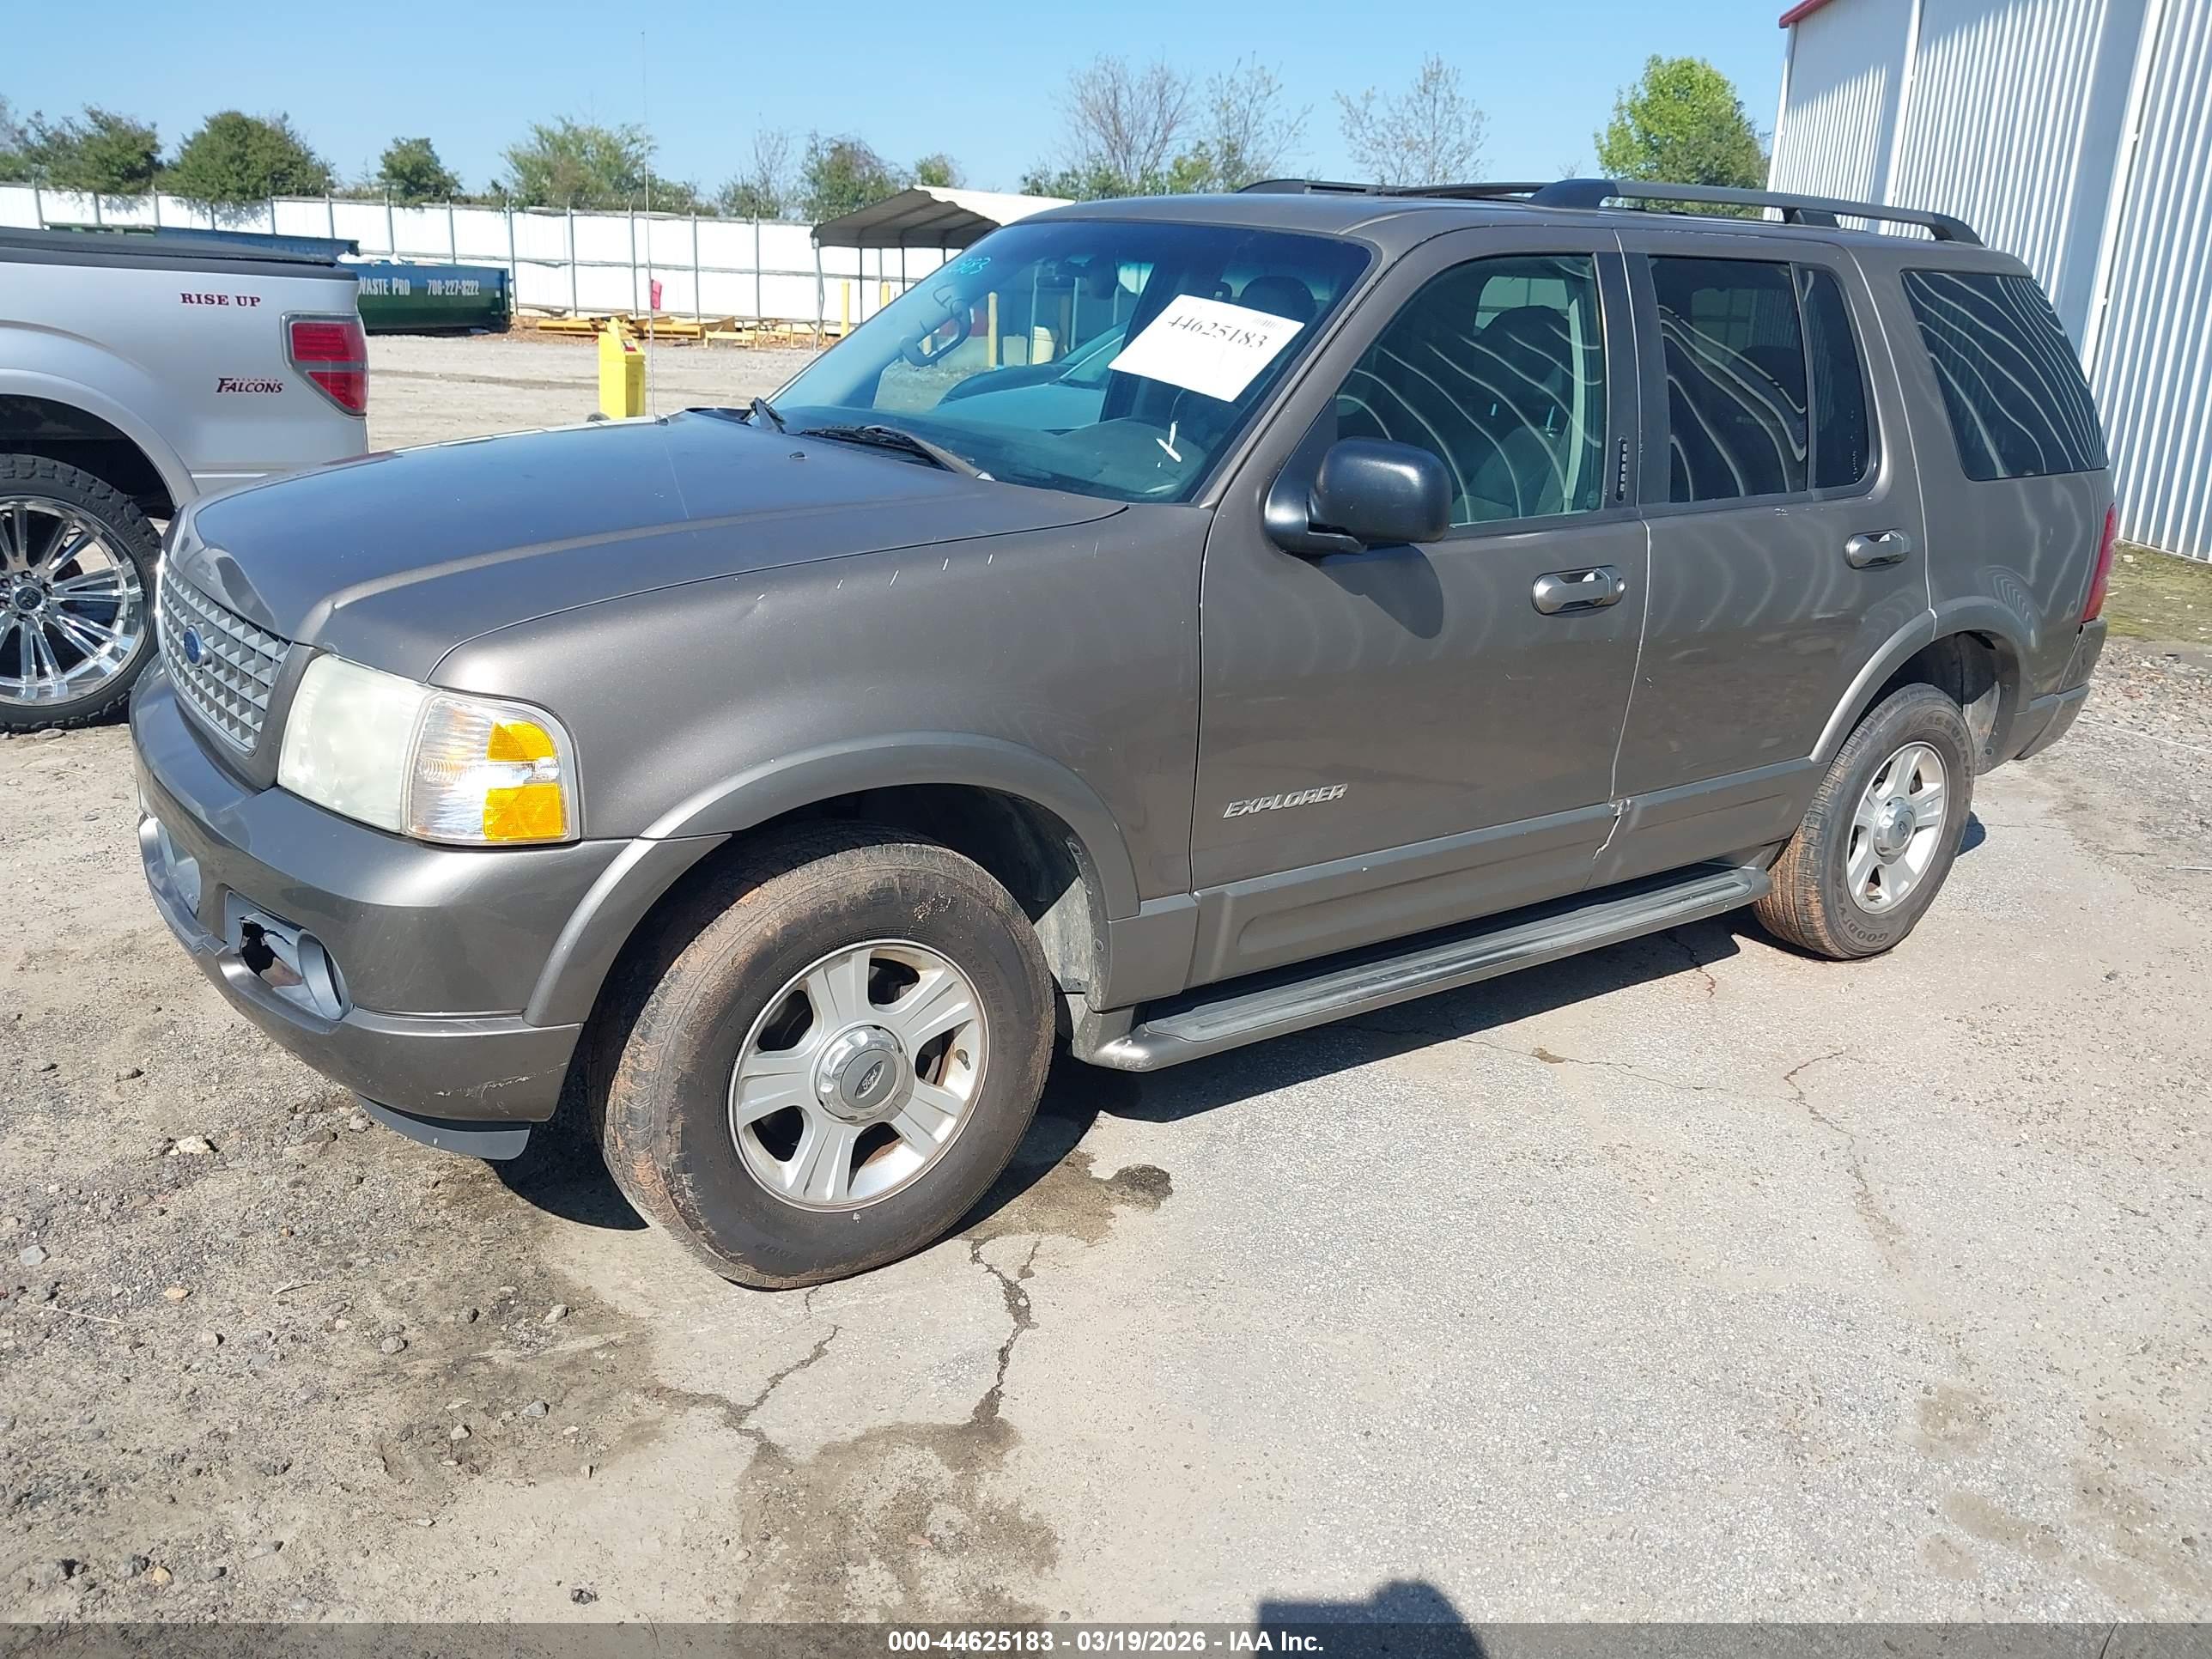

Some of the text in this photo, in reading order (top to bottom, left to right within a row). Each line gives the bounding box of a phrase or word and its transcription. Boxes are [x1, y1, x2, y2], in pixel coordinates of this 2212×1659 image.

[180, 292, 261, 307] RISE UP
[1168, 315, 1268, 348] 44625183
[216, 377, 283, 393] FALCONS
[1223, 783, 1348, 819] EXPLORER
